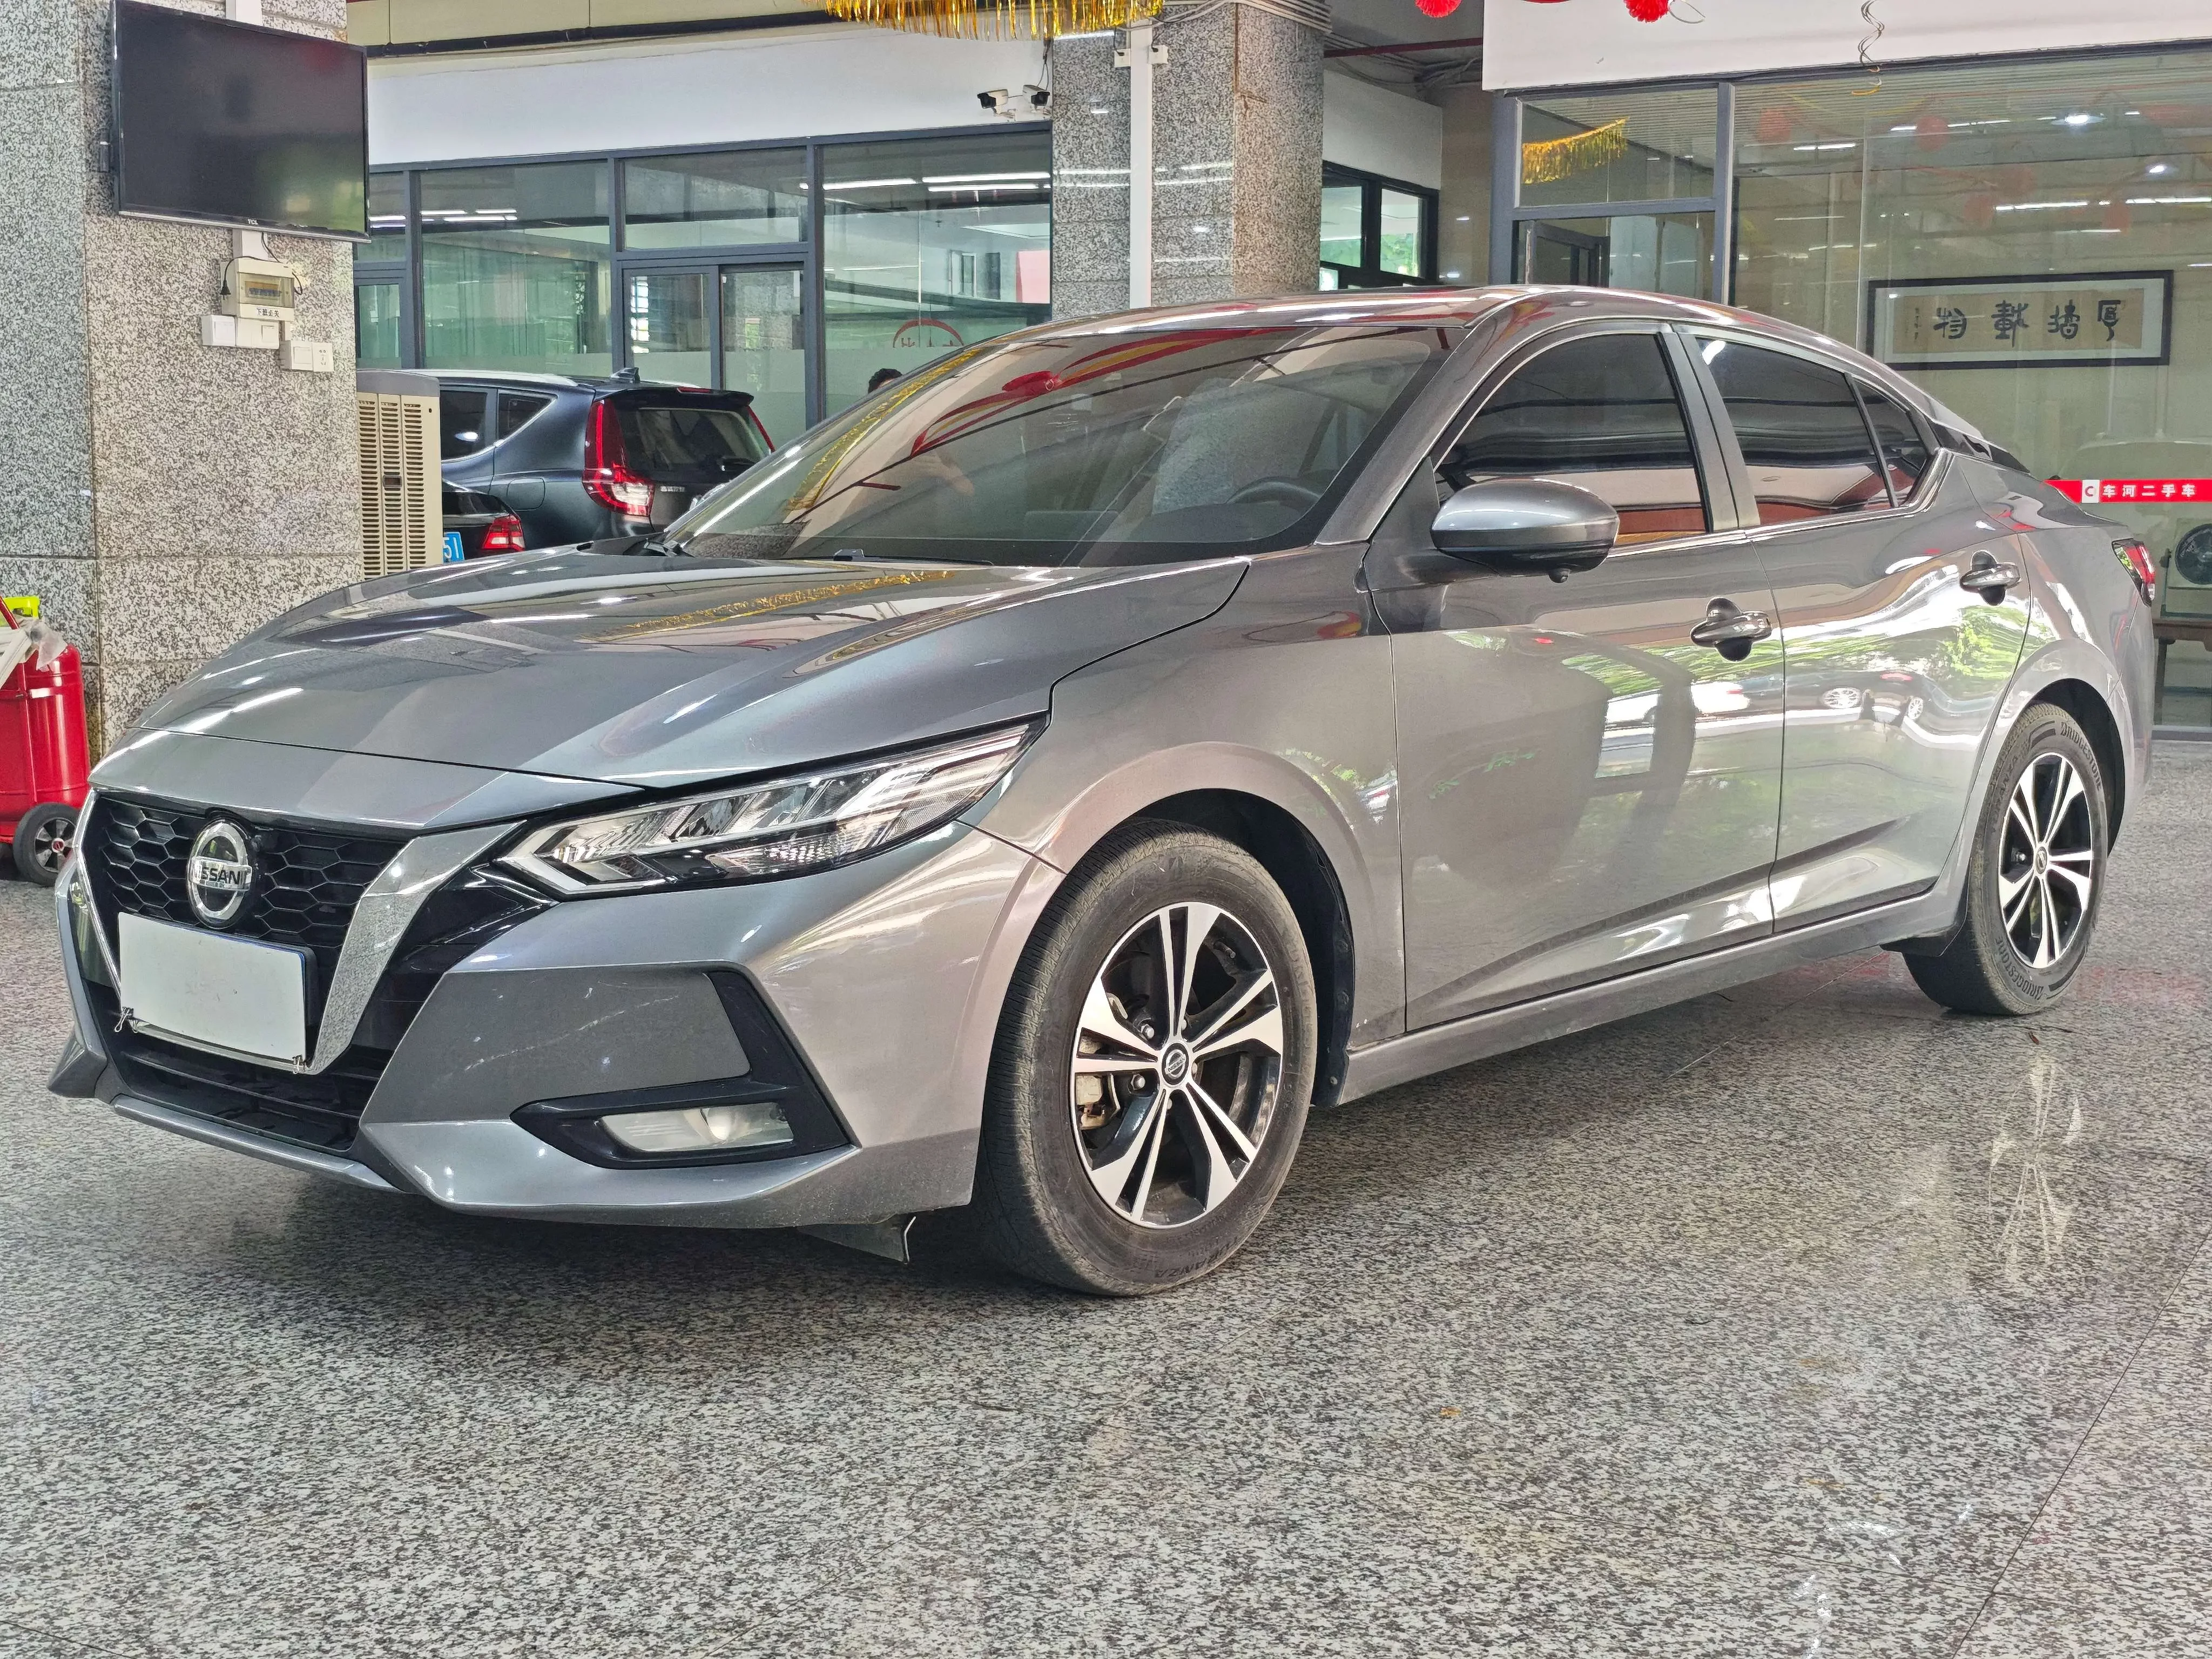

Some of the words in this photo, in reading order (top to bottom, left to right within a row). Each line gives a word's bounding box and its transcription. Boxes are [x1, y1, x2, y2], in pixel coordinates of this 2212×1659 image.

[2102, 484, 2196, 498] 车河二手车
